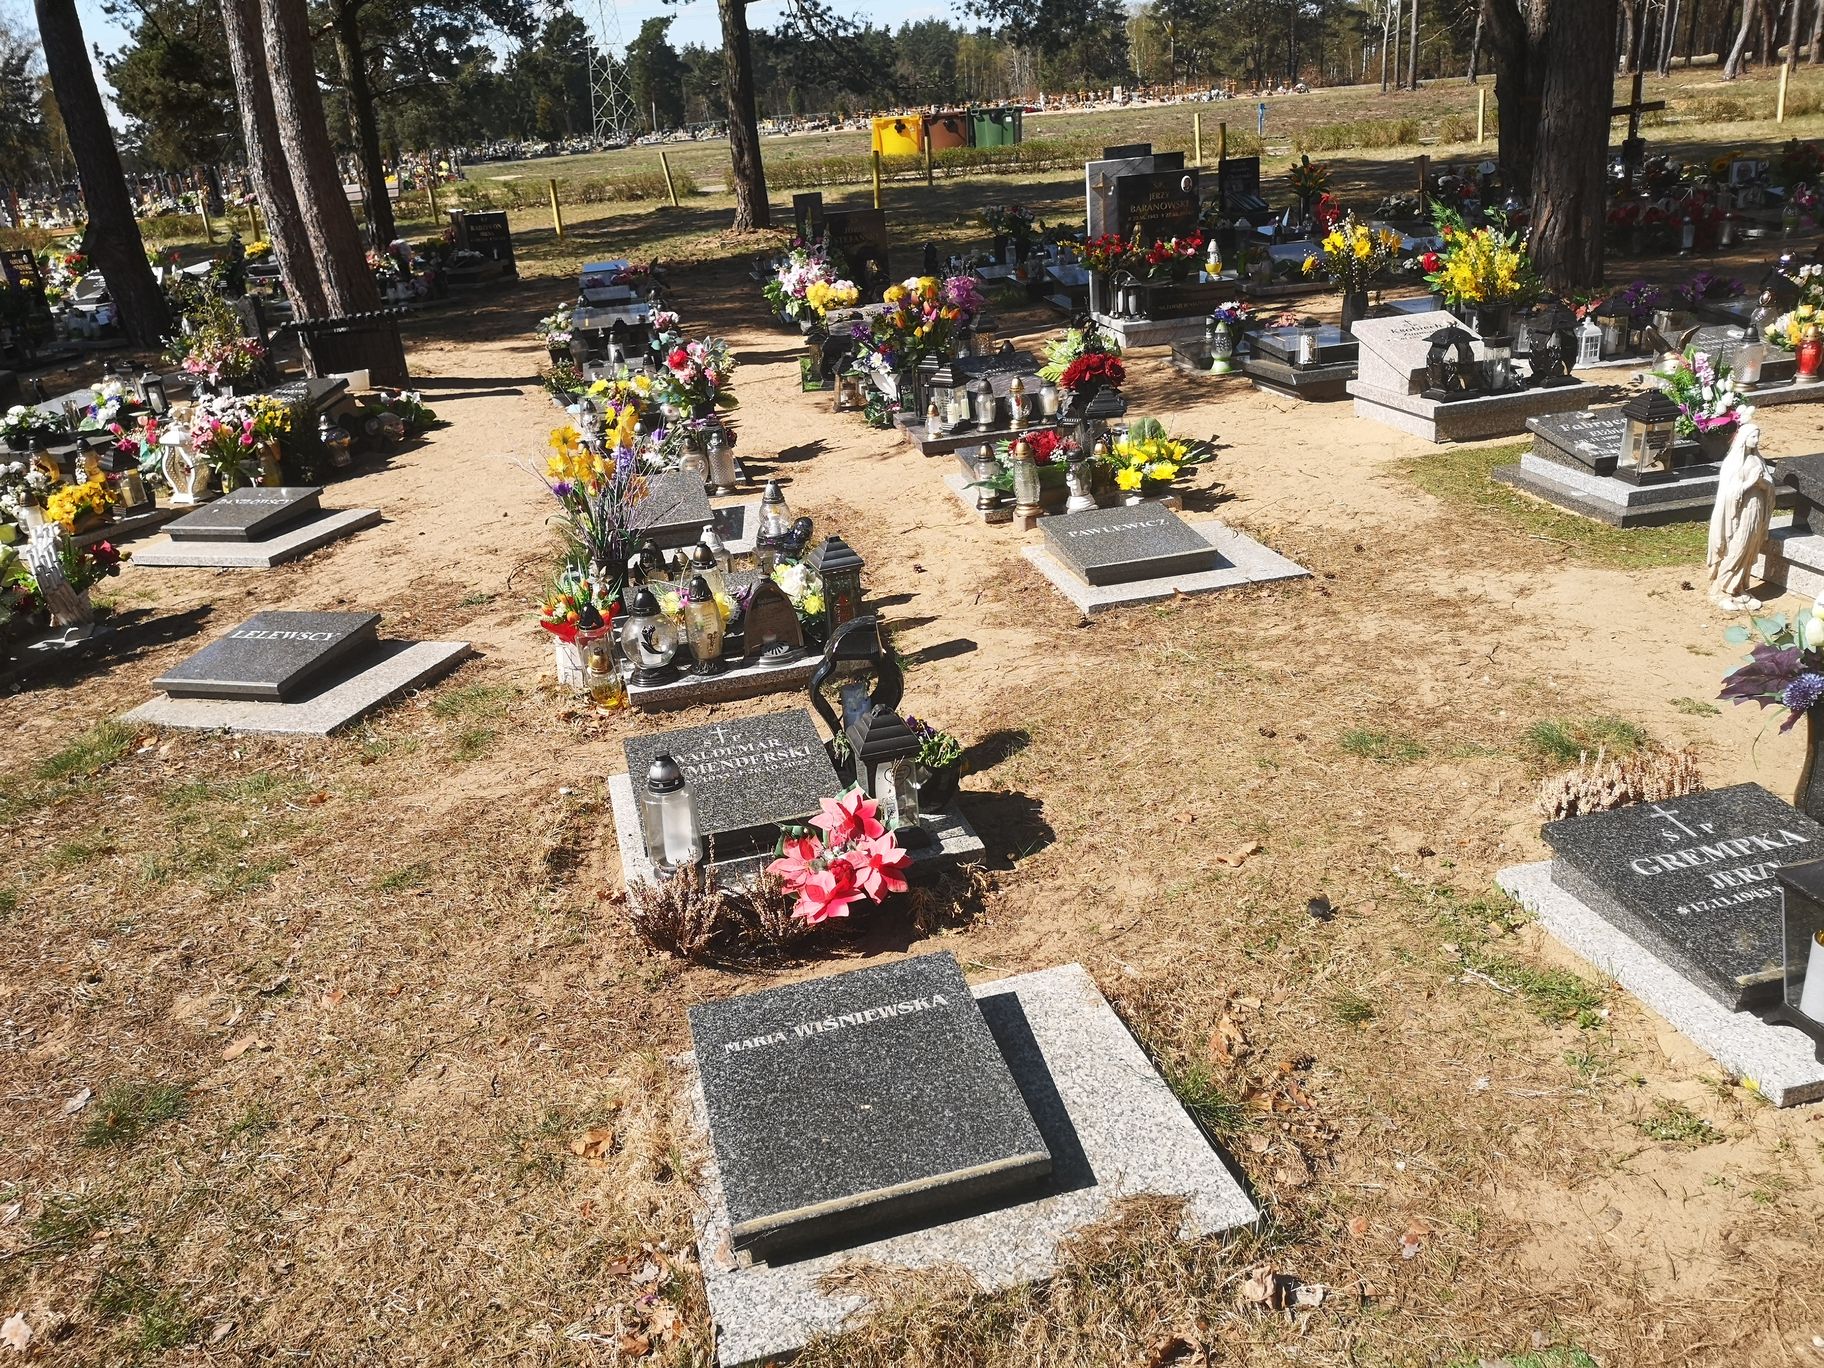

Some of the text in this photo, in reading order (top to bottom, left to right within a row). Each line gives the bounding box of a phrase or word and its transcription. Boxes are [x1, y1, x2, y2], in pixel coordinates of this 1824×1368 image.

[1067, 518, 1169, 538] PAWLEWICZ
[228, 630, 342, 641] LELEWSCY
[1698, 823, 1714, 834] P
[1630, 829, 1811, 876] GREMPKA
[724, 993, 950, 1055] MARIA WIŚNIEWSKA
